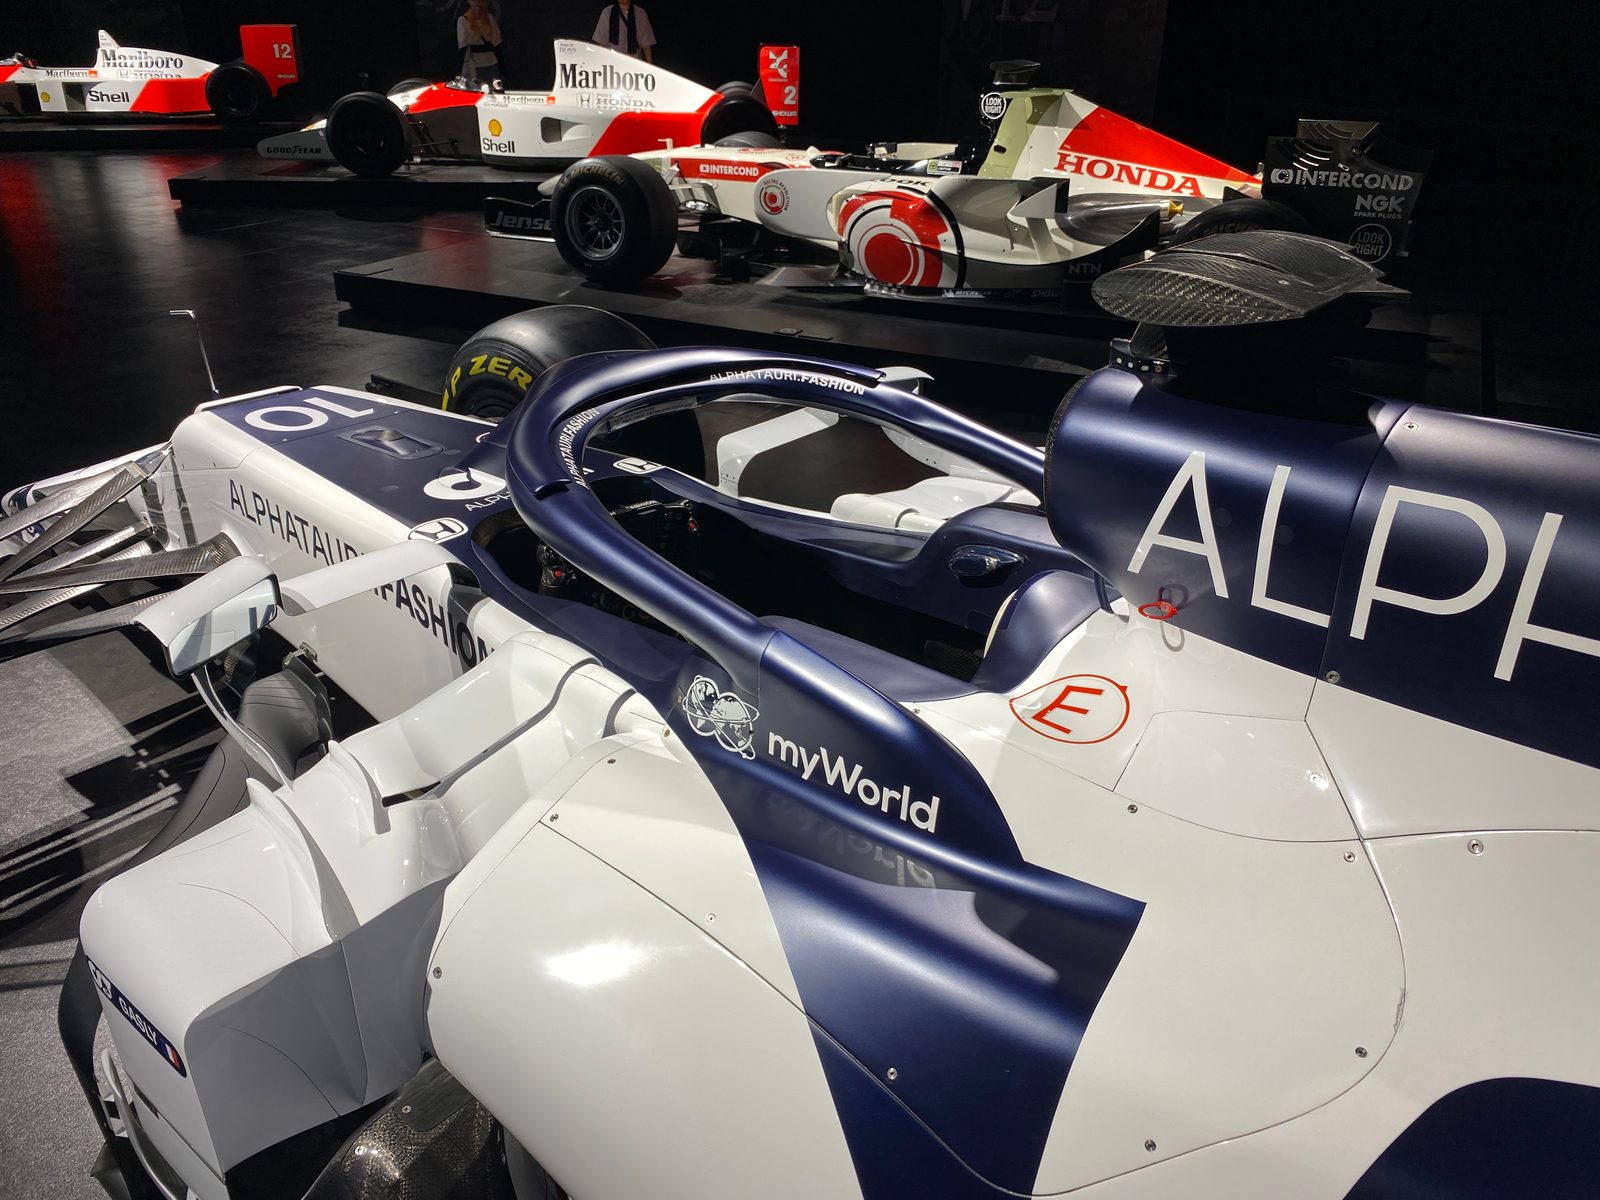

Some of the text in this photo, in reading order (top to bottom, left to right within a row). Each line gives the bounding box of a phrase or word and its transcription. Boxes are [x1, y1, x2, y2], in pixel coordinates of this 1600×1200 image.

[101, 49, 183, 69] Marlboro
[272, 43, 292, 59] 12
[46, 70, 88, 78] Marlboro
[560, 63, 656, 92] Marlboro
[88, 90, 131, 103] Shell
[596, 98, 656, 108] HONDA
[784, 86, 797, 105] 2
[985, 97, 1002, 106] LOOK
[984, 105, 1003, 114] RIGHT
[266, 146, 321, 155] GOODYEAR
[483, 138, 516, 153] Shell
[570, 165, 625, 186] MICHELIN
[710, 164, 760, 176] INTERCOND
[1053, 152, 1205, 199] HONDA
[1295, 169, 1415, 191] INTERCOND
[1354, 194, 1406, 213] NGK
[1377, 212, 1402, 220] PLUGS
[1357, 231, 1385, 245] LOOK
[1354, 242, 1385, 256] RIGHT
[1068, 262, 1103, 275] NTN
[709, 370, 865, 396] ALPHATAURI.FASHION
[244, 396, 374, 432] 10
[1031, 685, 1104, 735] E
[768, 731, 941, 834] myWorld
[118, 996, 157, 1046] GASLY
